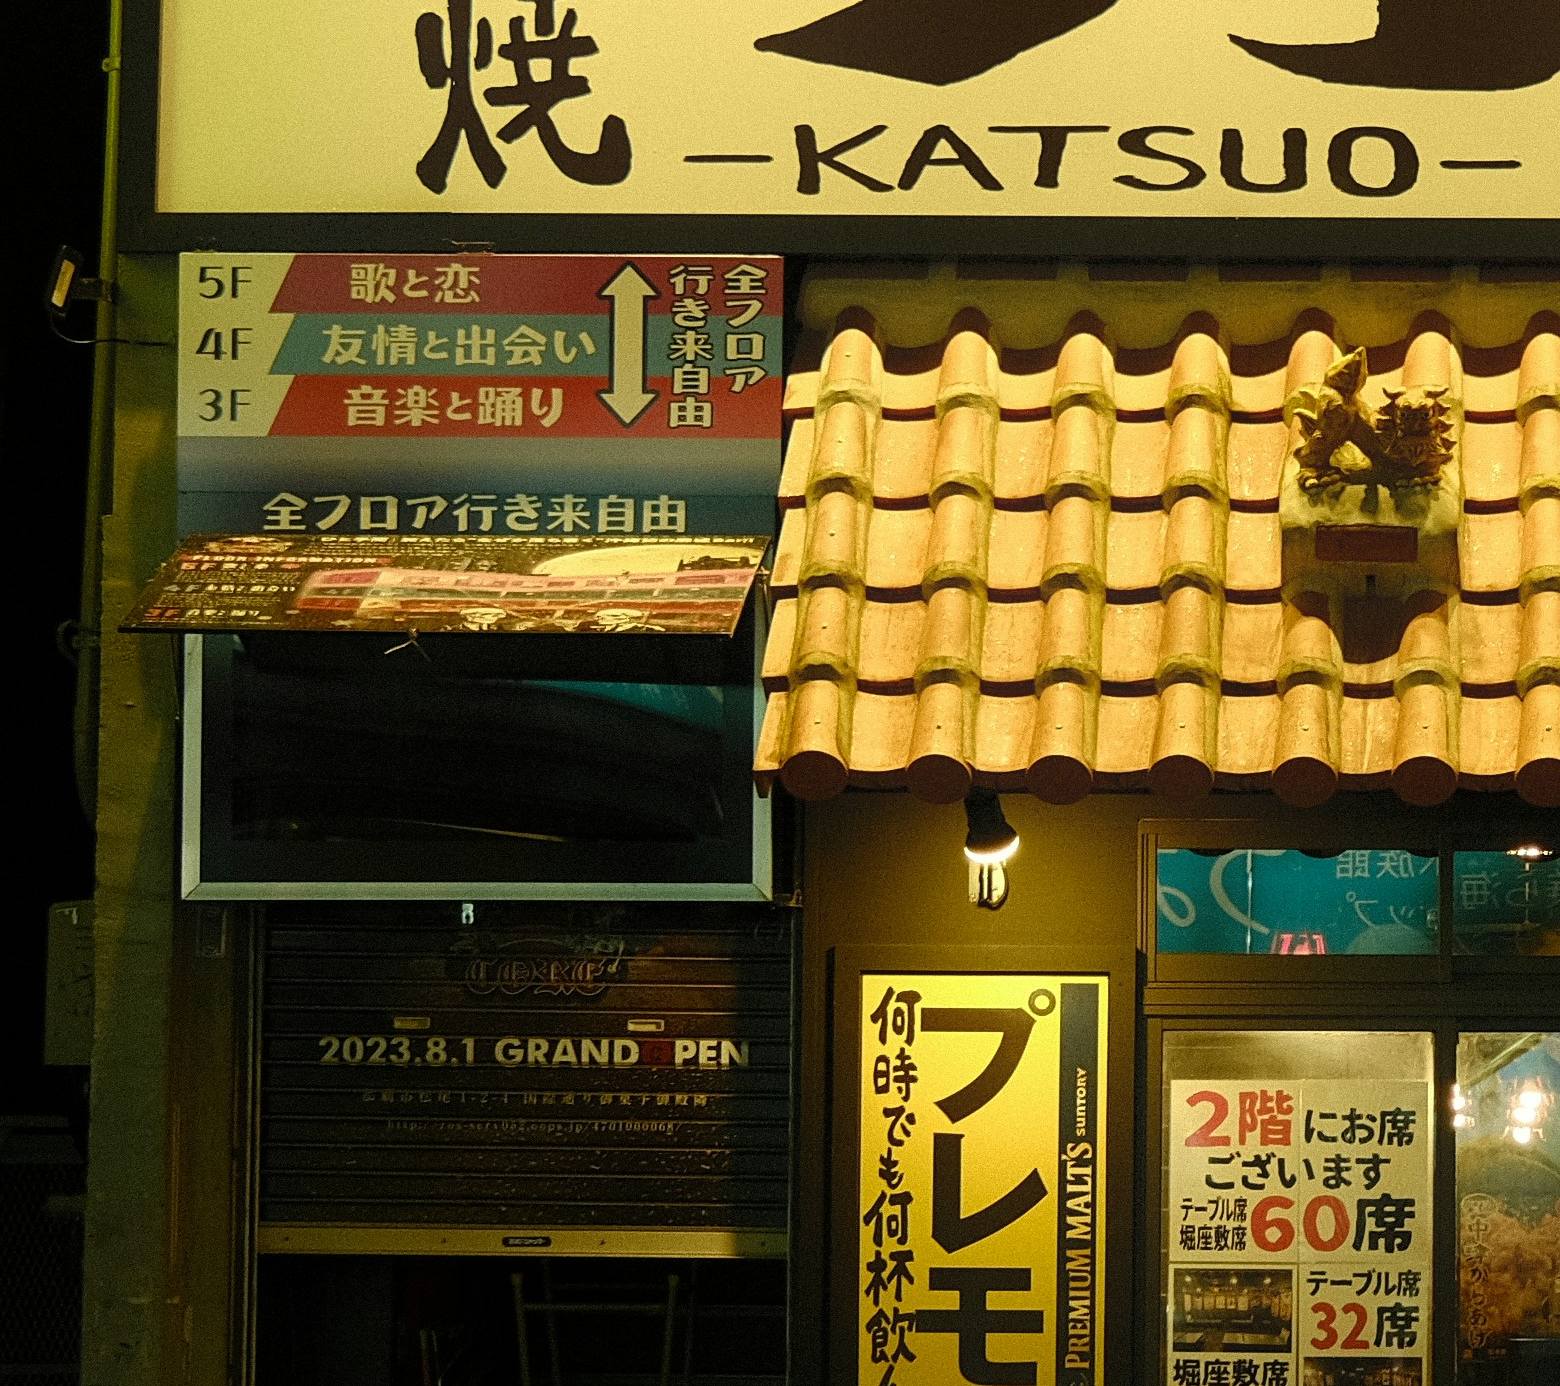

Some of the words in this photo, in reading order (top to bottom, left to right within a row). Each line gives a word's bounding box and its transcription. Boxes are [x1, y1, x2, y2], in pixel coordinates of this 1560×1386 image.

[196, 264, 253, 300] 5F
[349, 262, 481, 305] 歌と恋
[195, 326, 253, 362] 4F
[322, 324, 597, 367] 友情と出会い
[667, 263, 714, 429] 行き来自由
[723, 262, 770, 394] 全フロア
[196, 388, 252, 423] 3F
[343, 384, 565, 428] 音楽と踊り
[262, 491, 688, 535] 全フロア行き来自由
[319, 1035, 476, 1065] 2023.8.1
[495, 1037, 640, 1068] GRAND
[1184, 1089, 1416, 1149] 2階にお席
[1061, 1141, 1092, 1240] MALT'S
[1204, 1152, 1392, 1192] ございます
[1178, 1196, 1248, 1224] テーブル席
[1249, 1193, 1417, 1254] 60席
[1305, 1268, 1421, 1299] テーブル席
[1063, 1250, 1091, 1370] PREMIUM
[1309, 1301, 1420, 1350] 32席
